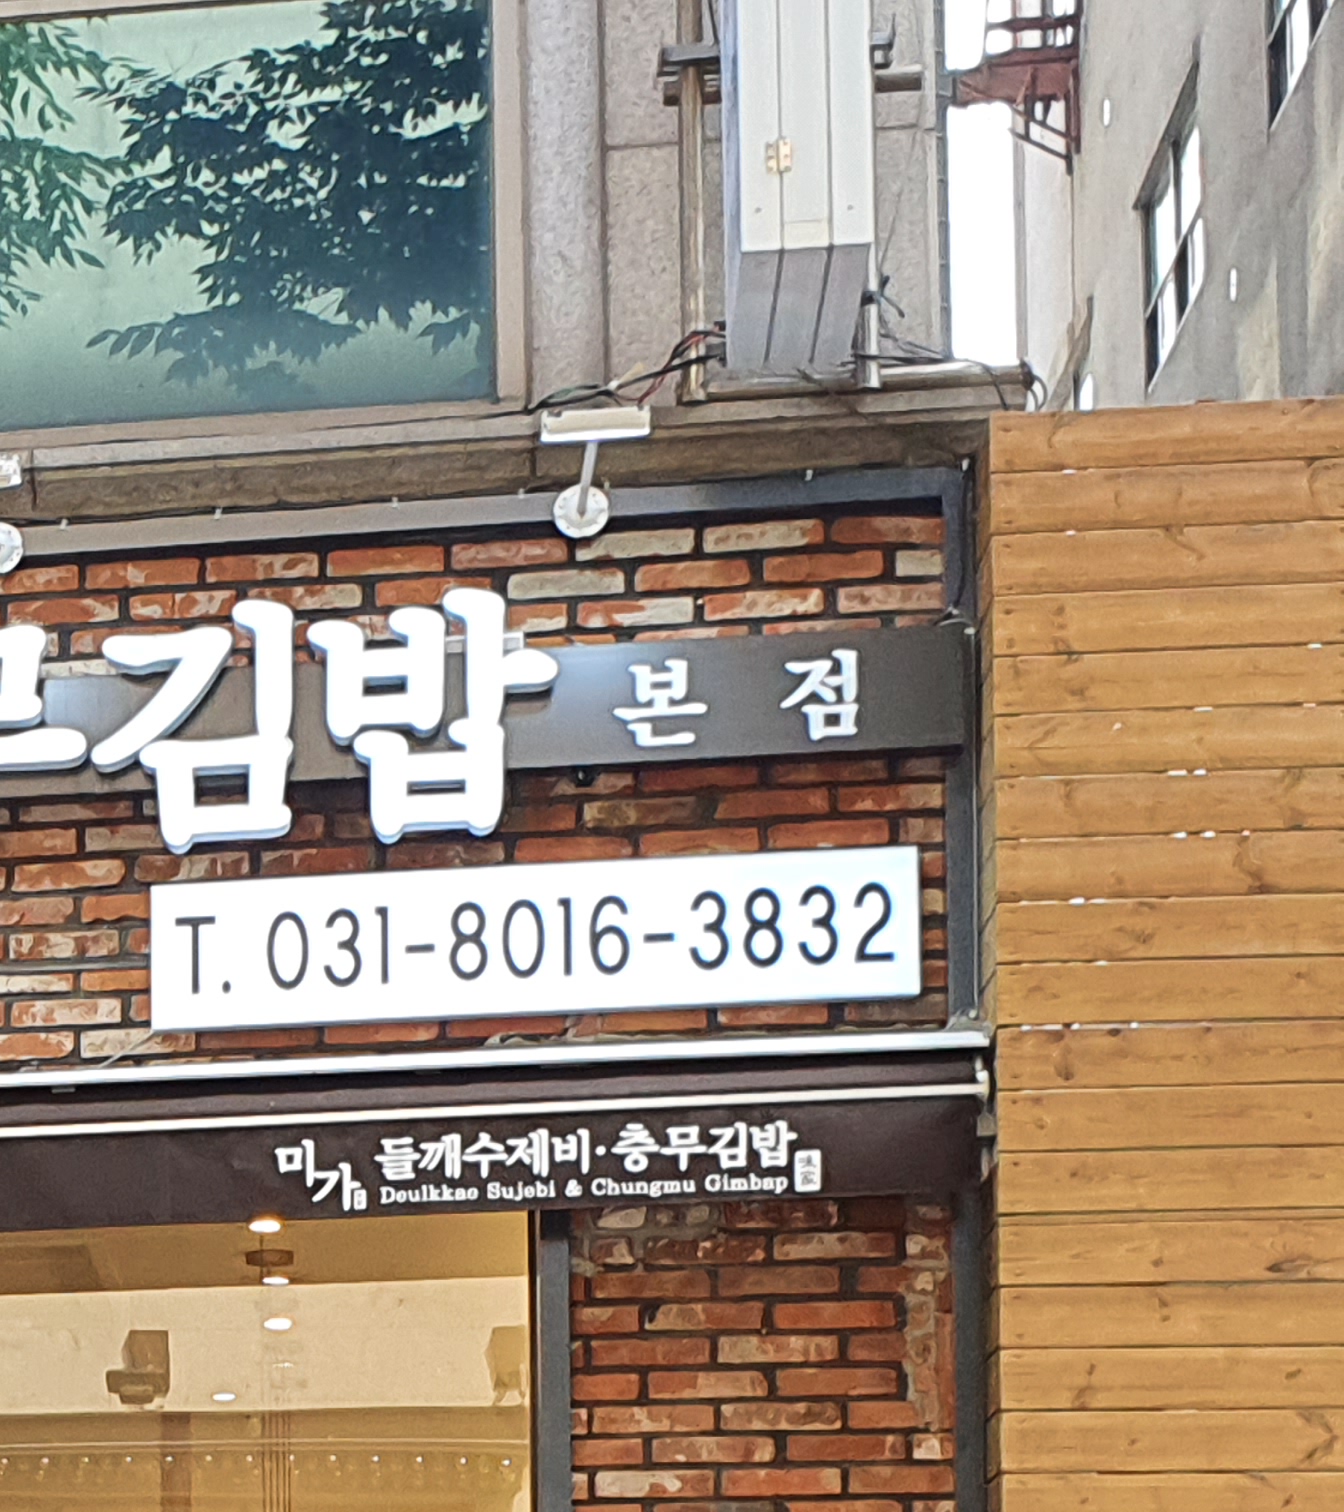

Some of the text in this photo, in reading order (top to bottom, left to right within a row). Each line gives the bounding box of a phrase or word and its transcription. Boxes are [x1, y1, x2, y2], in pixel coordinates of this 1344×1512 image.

[175, 880, 897, 996] T. 031-8016-3832
[275, 1138, 354, 1212] 미가
[564, 1179, 583, 1198] &
[590, 1177, 697, 1199] Chungmu
[704, 1173, 789, 1196] Gimbap
